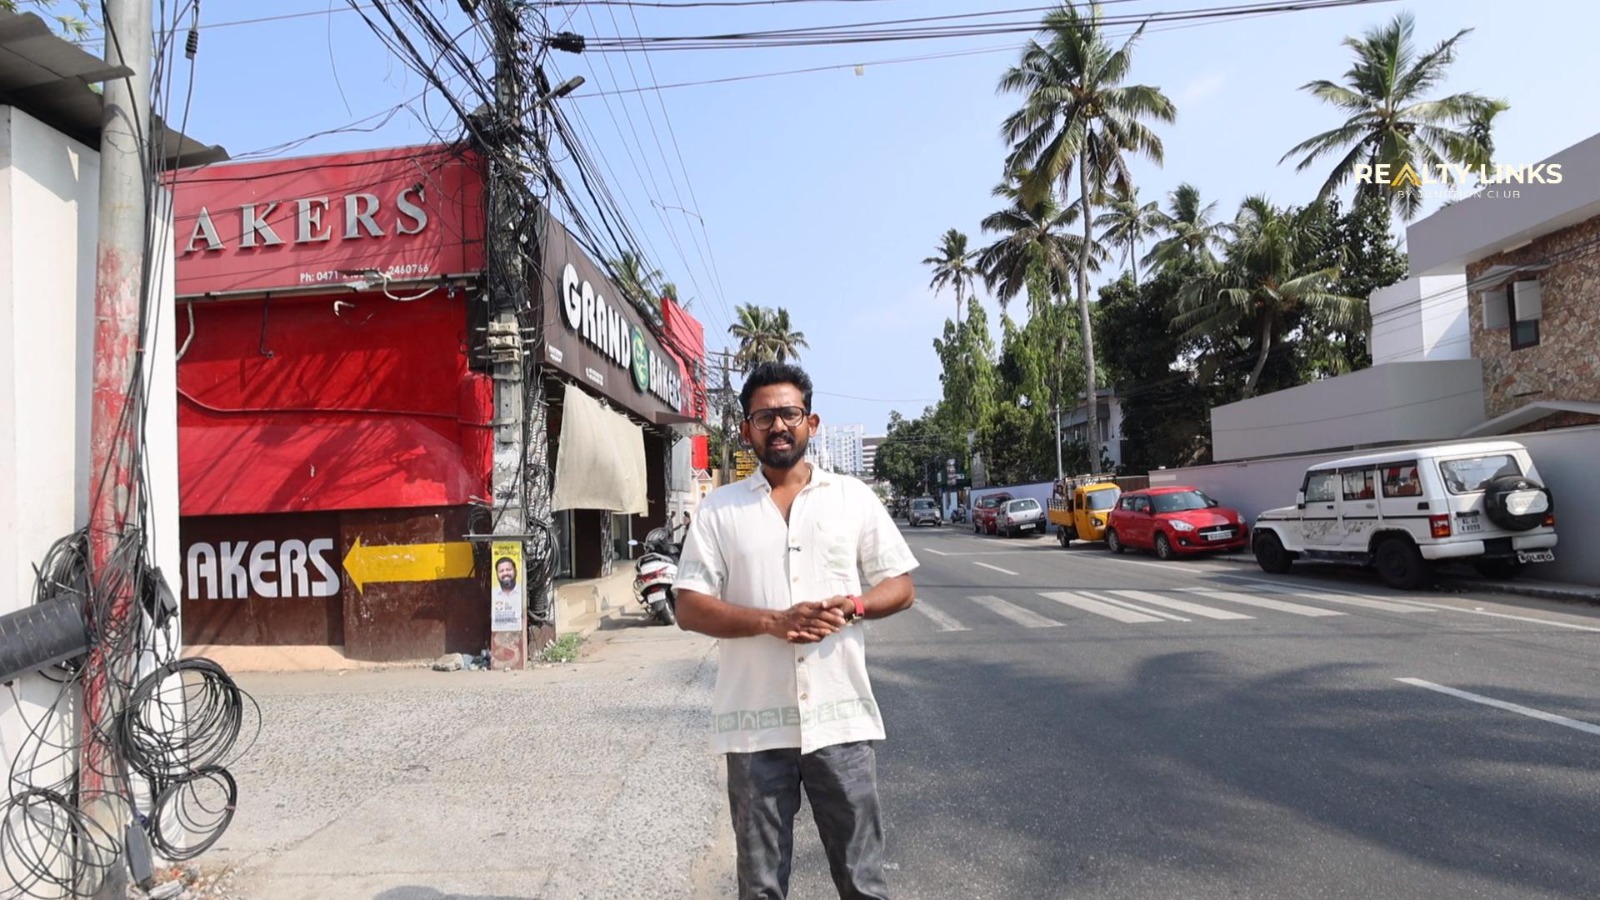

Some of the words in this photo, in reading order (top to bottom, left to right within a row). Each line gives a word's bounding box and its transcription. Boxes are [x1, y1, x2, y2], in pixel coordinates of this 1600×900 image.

[184, 187, 428, 253] AKERS
[317, 271, 338, 281] 0471
[563, 263, 631, 370] GRAND
[649, 350, 682, 412] BAKERS
[178, 538, 341, 600] AKERS
